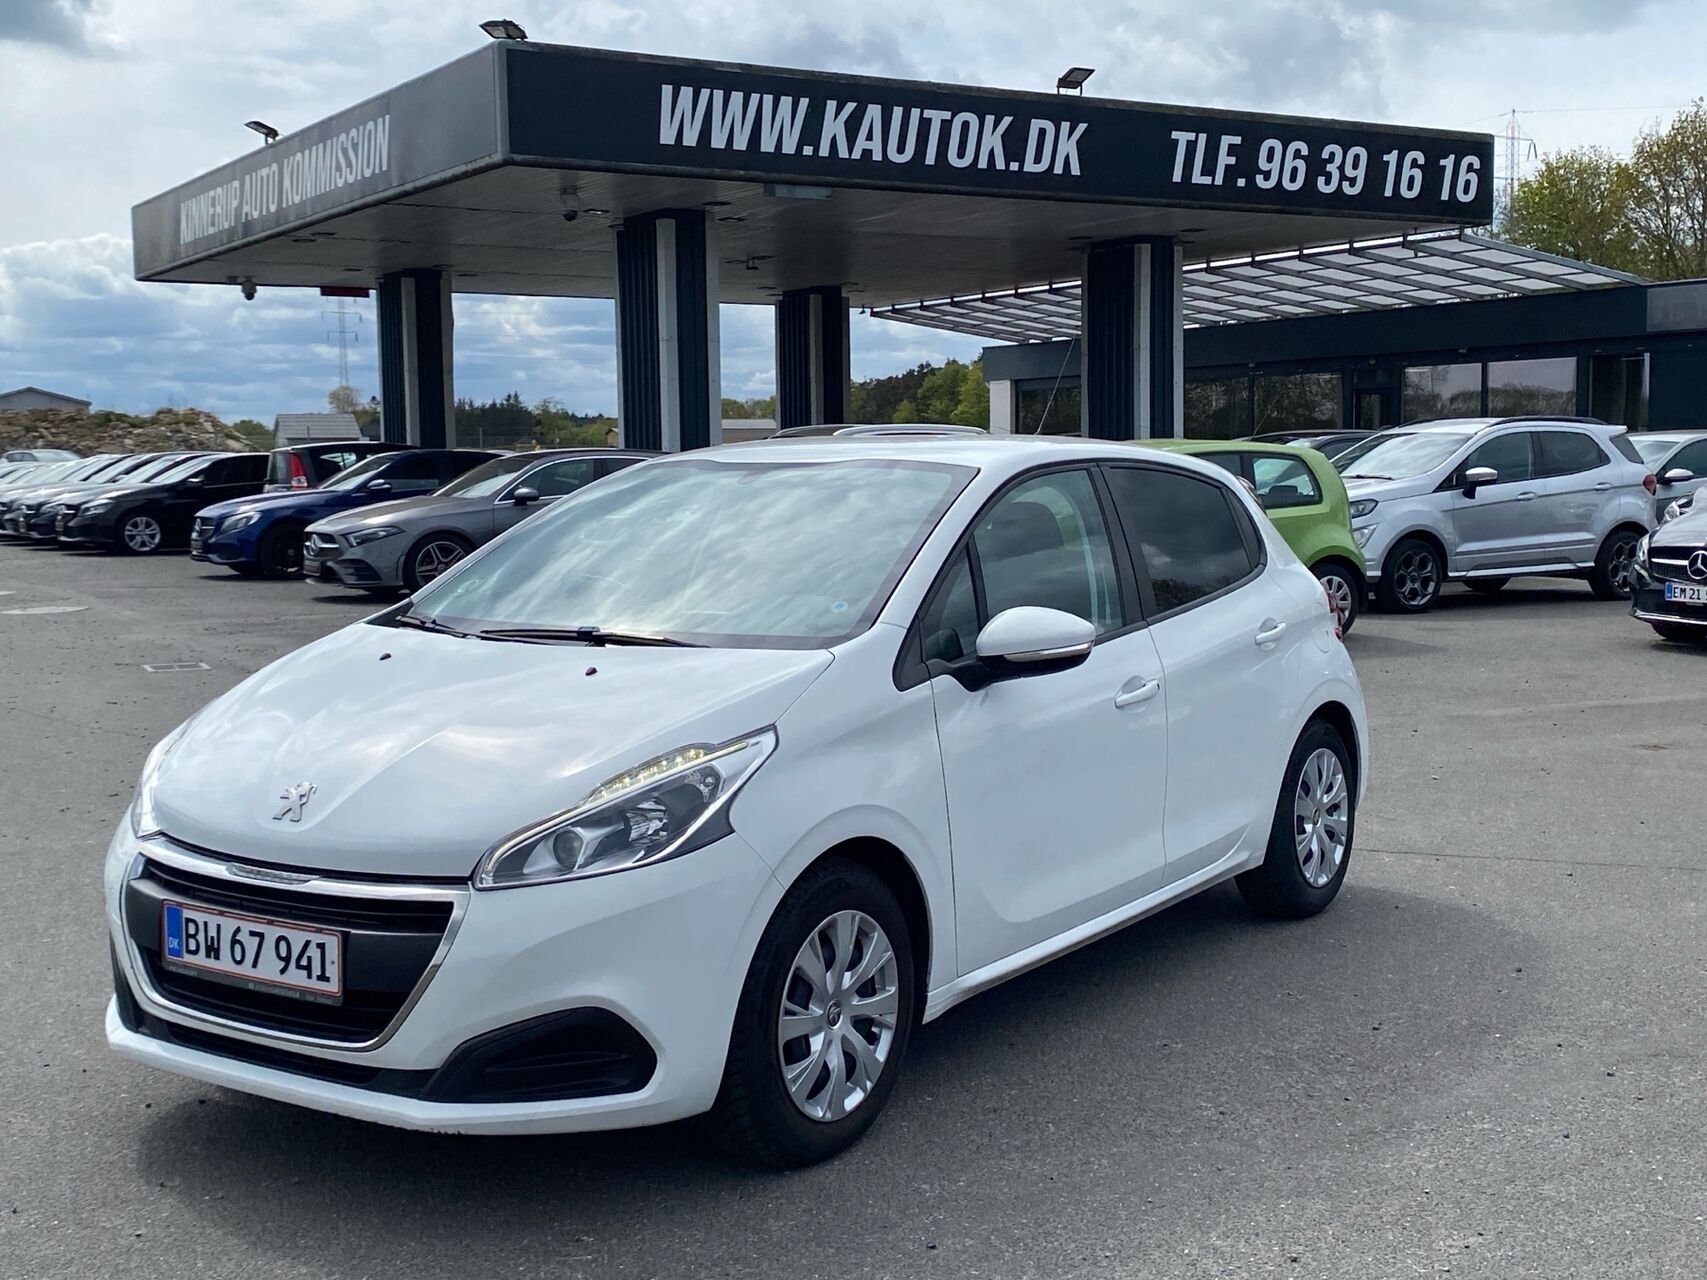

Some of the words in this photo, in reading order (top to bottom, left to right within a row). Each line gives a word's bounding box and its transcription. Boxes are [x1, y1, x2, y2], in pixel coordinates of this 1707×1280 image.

[659, 84, 1089, 176] WWW.KAUTOK.DK
[180, 180, 240, 245] KINNERUP
[241, 163, 279, 222] AUTO
[282, 114, 390, 208] KOMMISSION
[1171, 130, 1246, 187] TLF.
[1255, 138, 1309, 191] 96
[1317, 144, 1368, 195] 39
[1382, 150, 1425, 199] 16
[1439, 154, 1481, 203] 16
[1673, 586, 1687, 600] EM
[1689, 588, 1701, 600] 21
[168, 937, 180, 950] DK
[184, 917, 221, 960] BW
[230, 926, 266, 969] 67
[274, 935, 331, 983] 941
